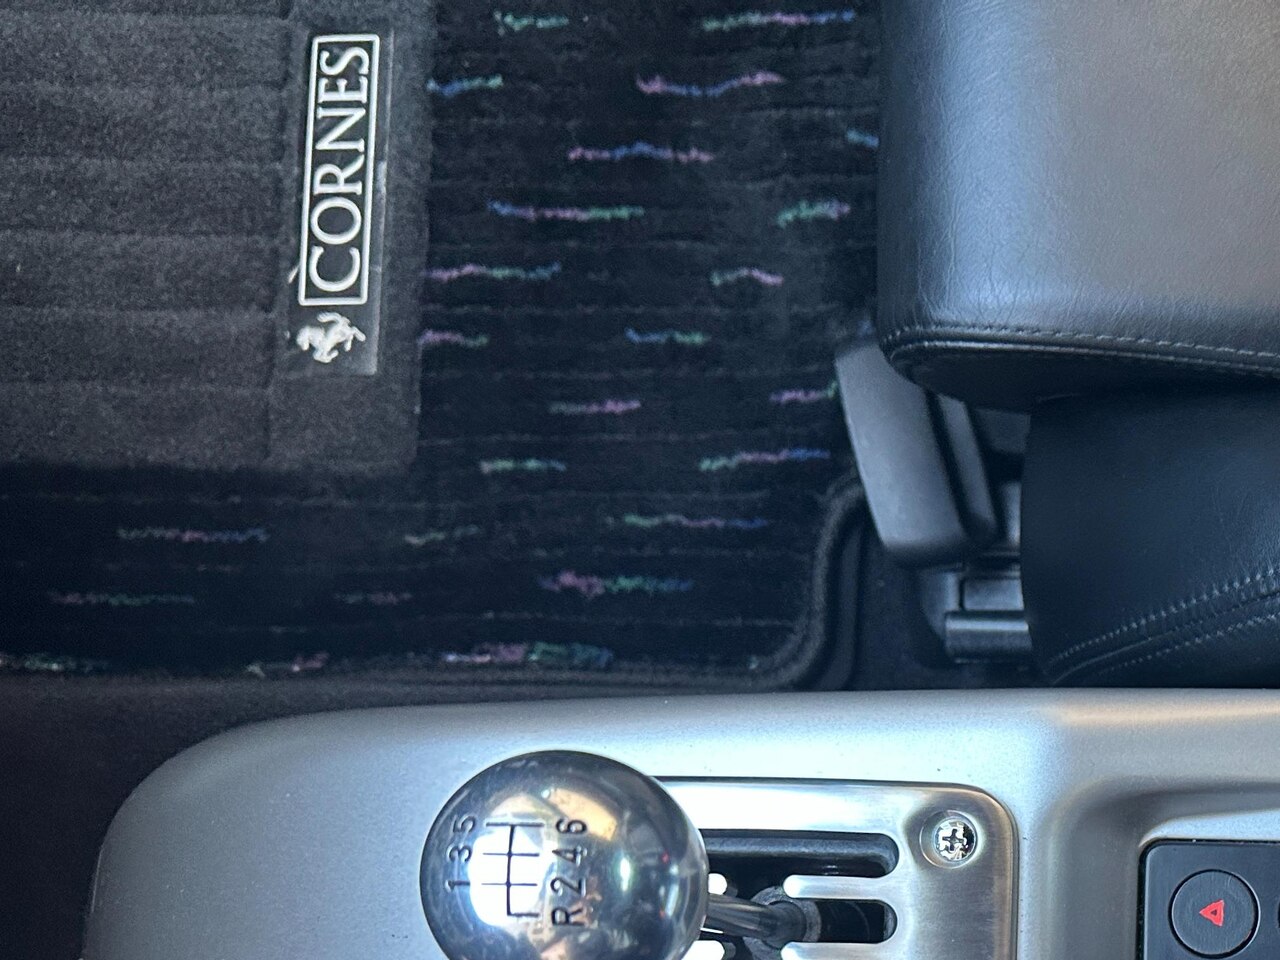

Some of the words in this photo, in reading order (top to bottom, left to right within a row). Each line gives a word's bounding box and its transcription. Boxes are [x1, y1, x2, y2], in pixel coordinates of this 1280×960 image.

[309, 46, 370, 292] CORNES
[452, 814, 476, 833] 5
[556, 818, 587, 834] 6
[446, 845, 472, 862] 3
[552, 846, 587, 866] 4
[446, 878, 471, 892] 1
[550, 876, 587, 896] 2
[551, 905, 585, 925] R
